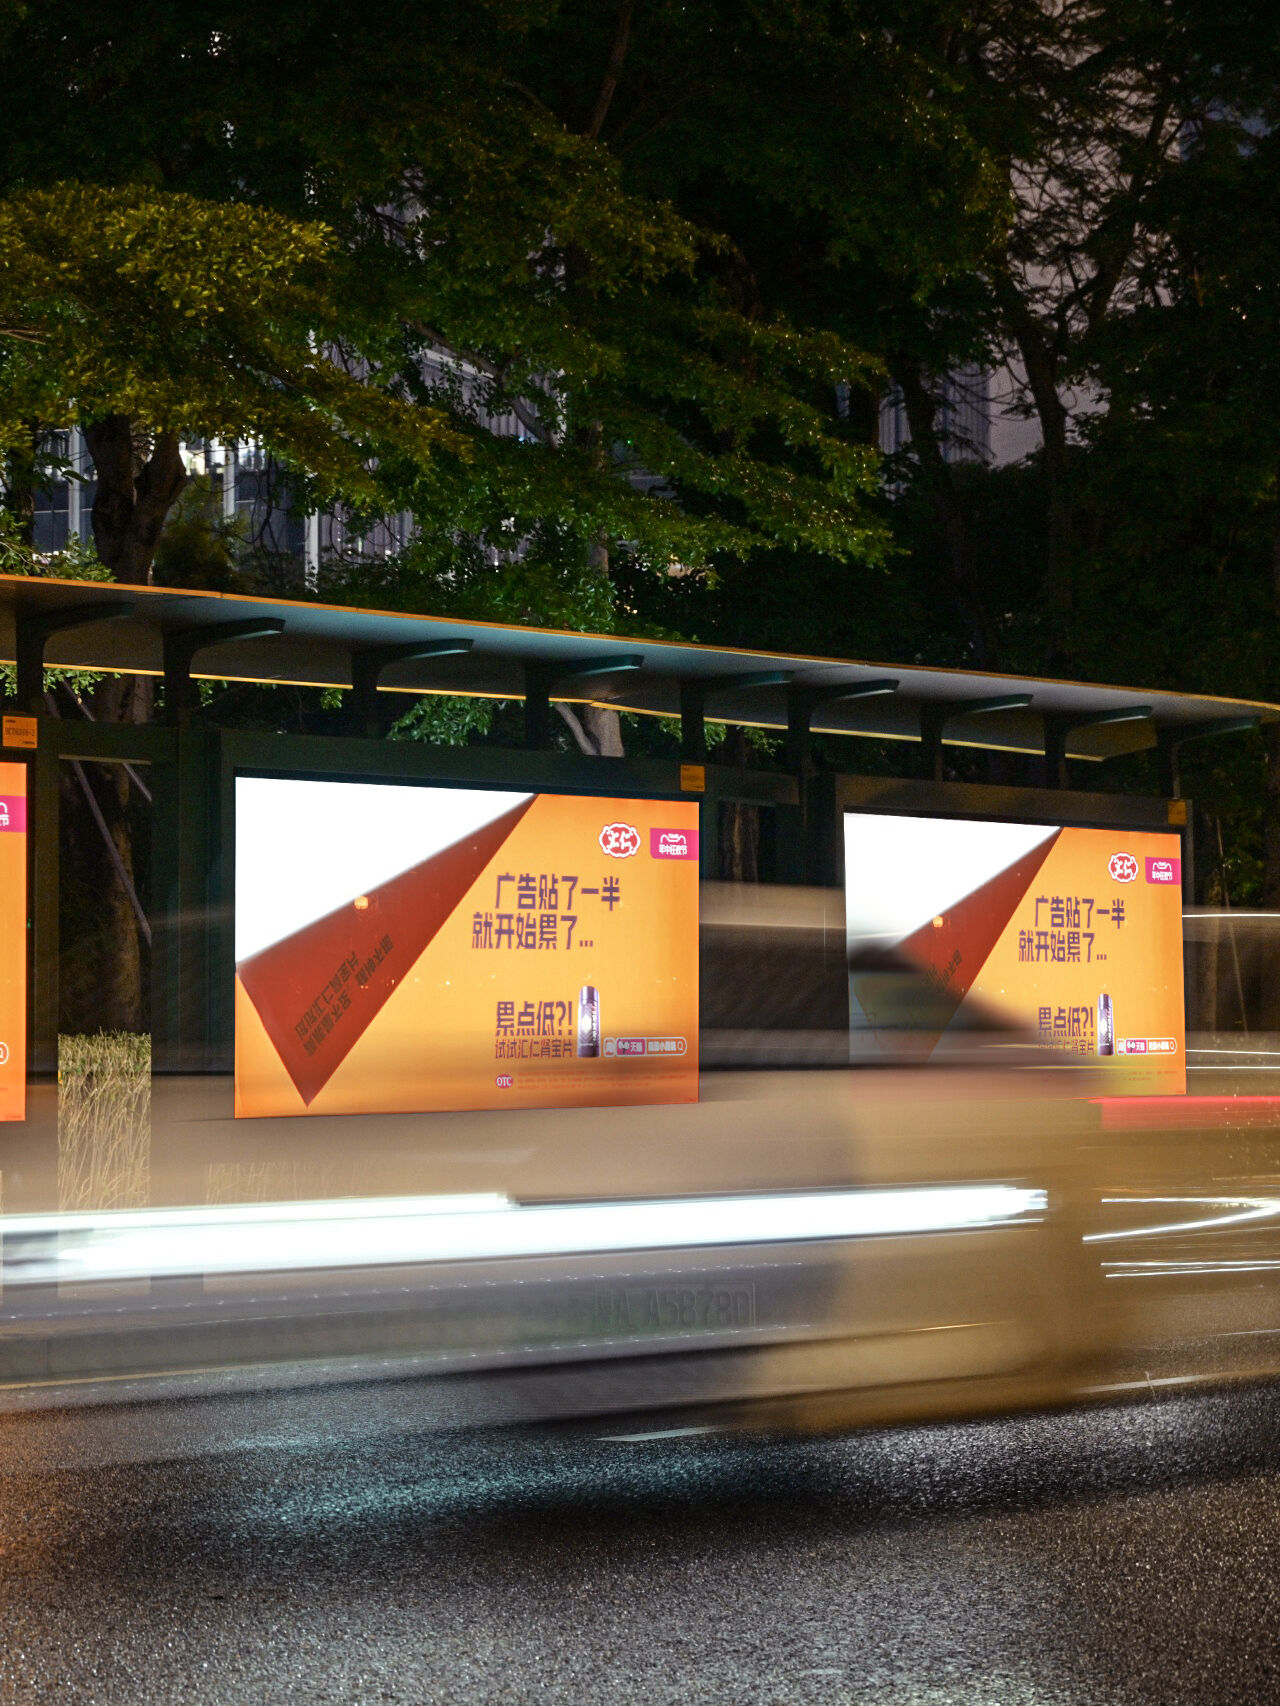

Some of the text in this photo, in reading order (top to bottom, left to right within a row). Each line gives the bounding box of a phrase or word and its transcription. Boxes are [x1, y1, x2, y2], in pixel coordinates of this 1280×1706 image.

[495, 873, 621, 912] 广告贴了一半
[1034, 896, 1126, 930] 广告贴了一半
[495, 1038, 573, 1060] 试试汇仁肾宝片
[496, 1076, 513, 1087] OTC
